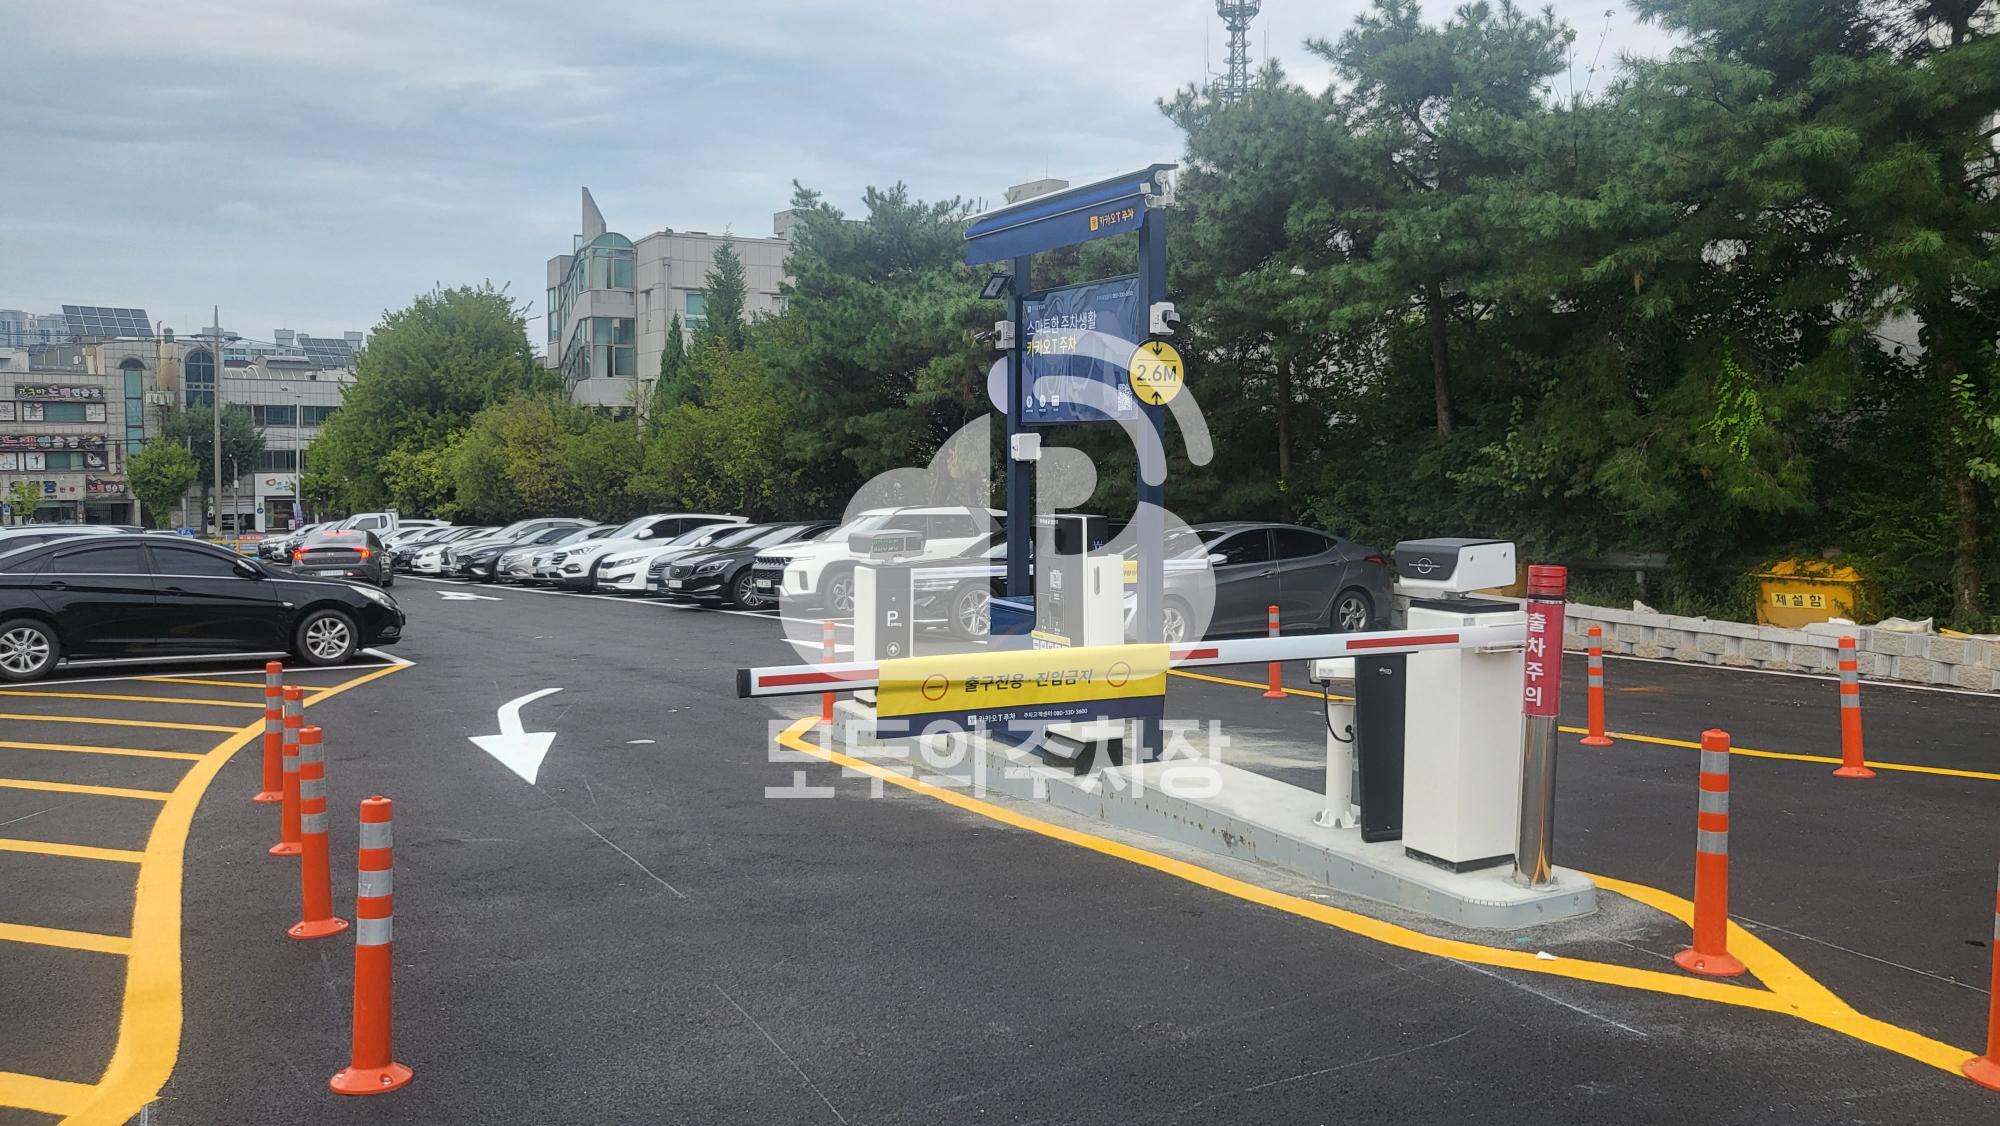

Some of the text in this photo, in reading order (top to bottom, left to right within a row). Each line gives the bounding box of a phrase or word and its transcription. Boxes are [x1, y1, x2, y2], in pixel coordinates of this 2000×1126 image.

[1027, 310, 1097, 336] 스마트한 주차생활
[1059, 335, 1077, 353] 주차
[1136, 364, 1177, 382] 2.6M
[1776, 593, 1822, 607] 제설함
[1525, 612, 1547, 707] 출차주의
[964, 669, 1094, 693] 출구전용 진입금지
